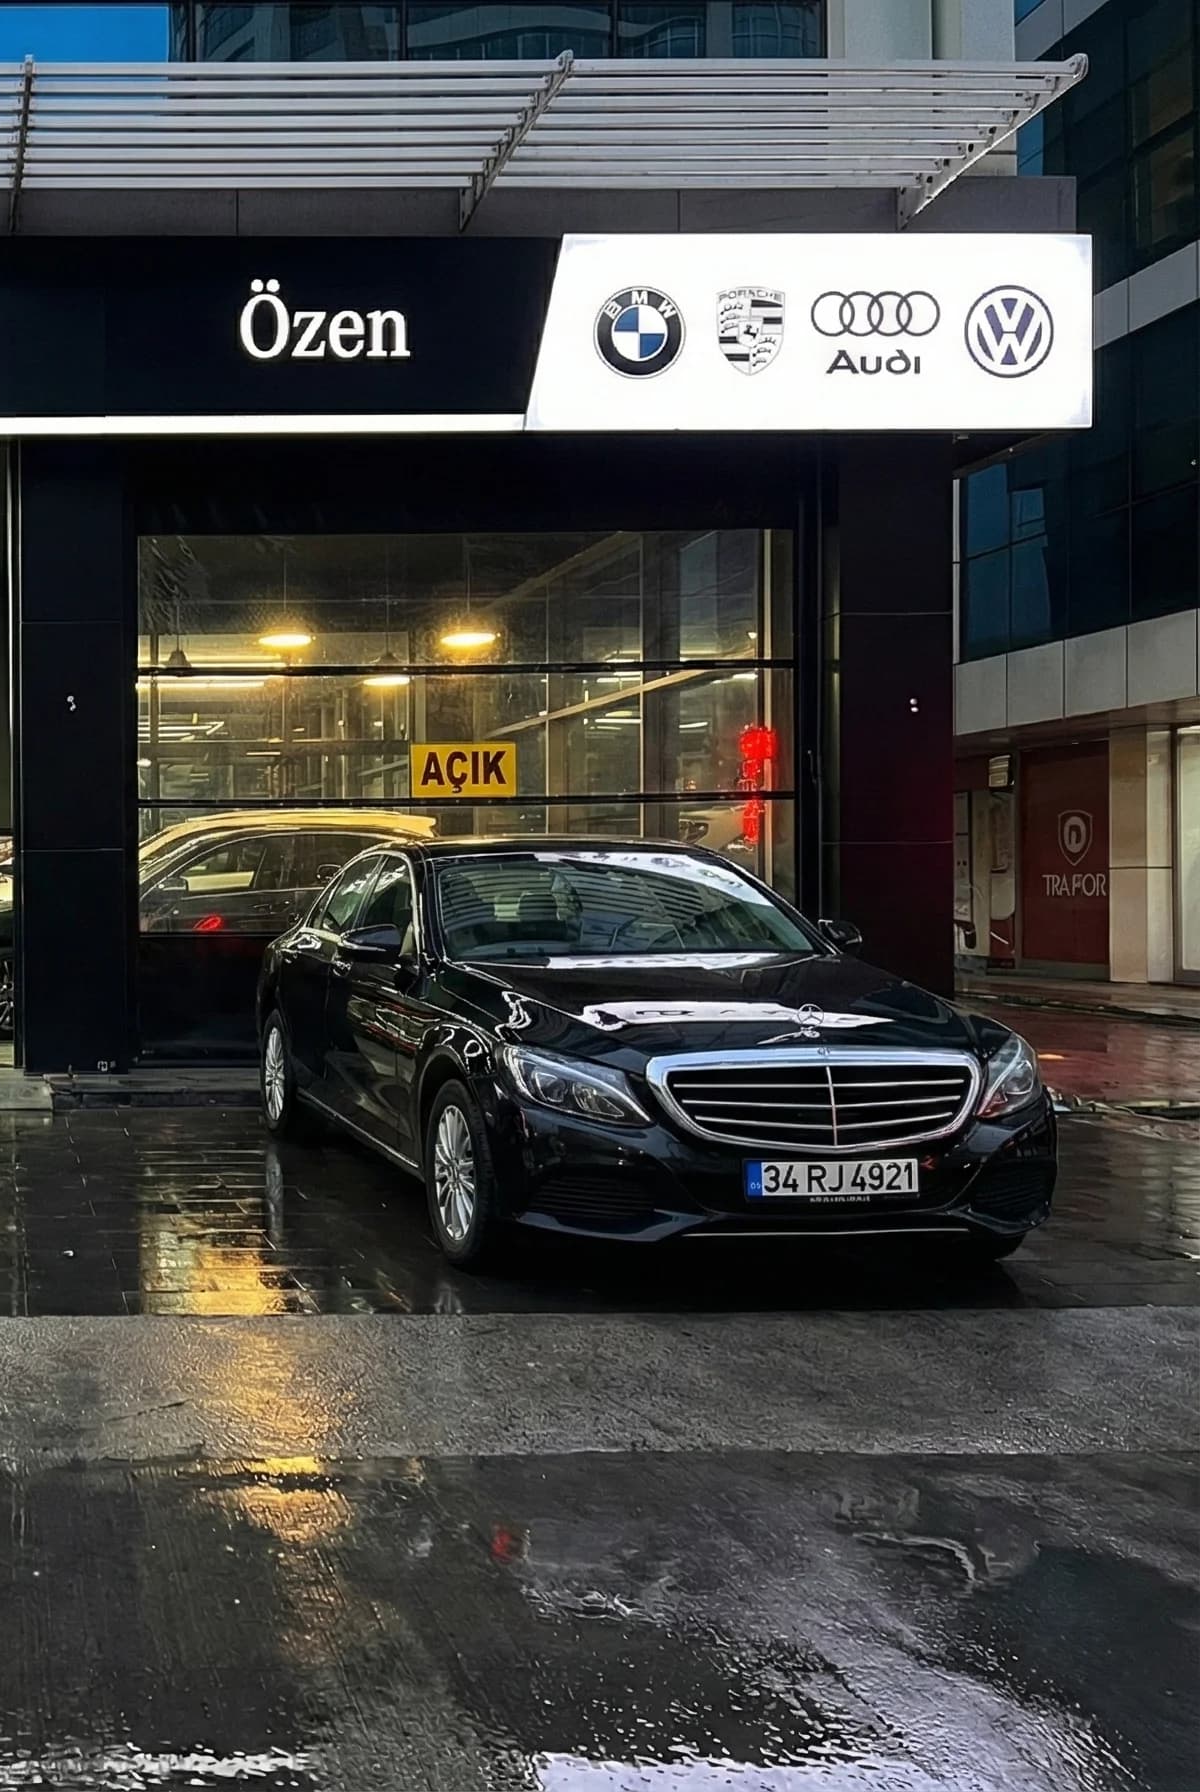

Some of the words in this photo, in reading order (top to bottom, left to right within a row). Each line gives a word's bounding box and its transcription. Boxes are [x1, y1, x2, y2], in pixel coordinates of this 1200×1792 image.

[239, 278, 411, 359] Özen
[825, 349, 921, 374] Audi
[420, 750, 507, 793] AÇIK
[763, 1164, 799, 1193] 34
[807, 1164, 844, 1192] RJ
[851, 1161, 913, 1191] 4921
